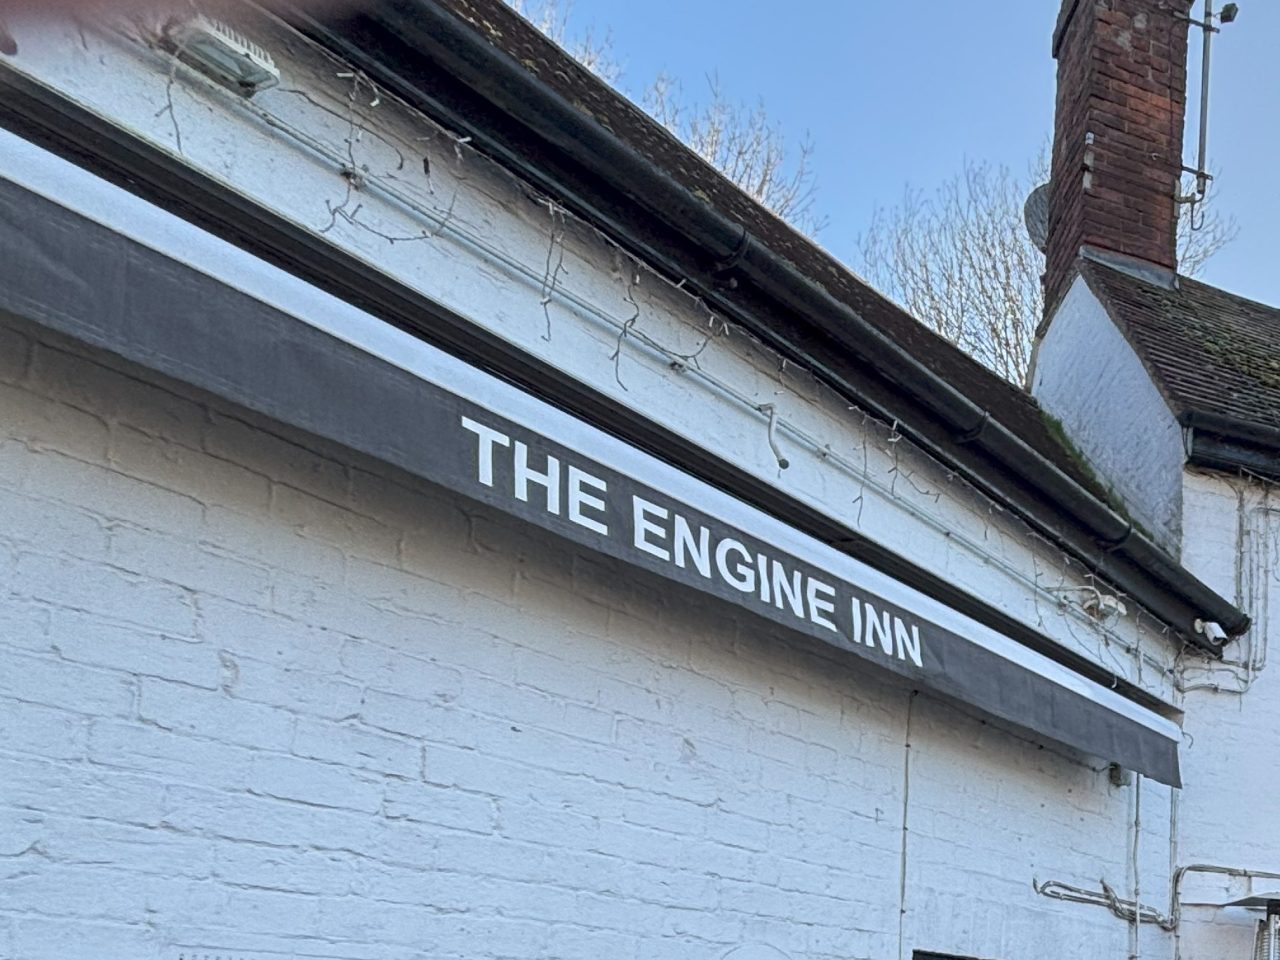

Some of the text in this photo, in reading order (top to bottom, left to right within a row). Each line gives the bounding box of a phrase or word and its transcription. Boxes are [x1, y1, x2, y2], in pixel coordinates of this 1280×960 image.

[461, 414, 923, 669] THE ENGINE INN
